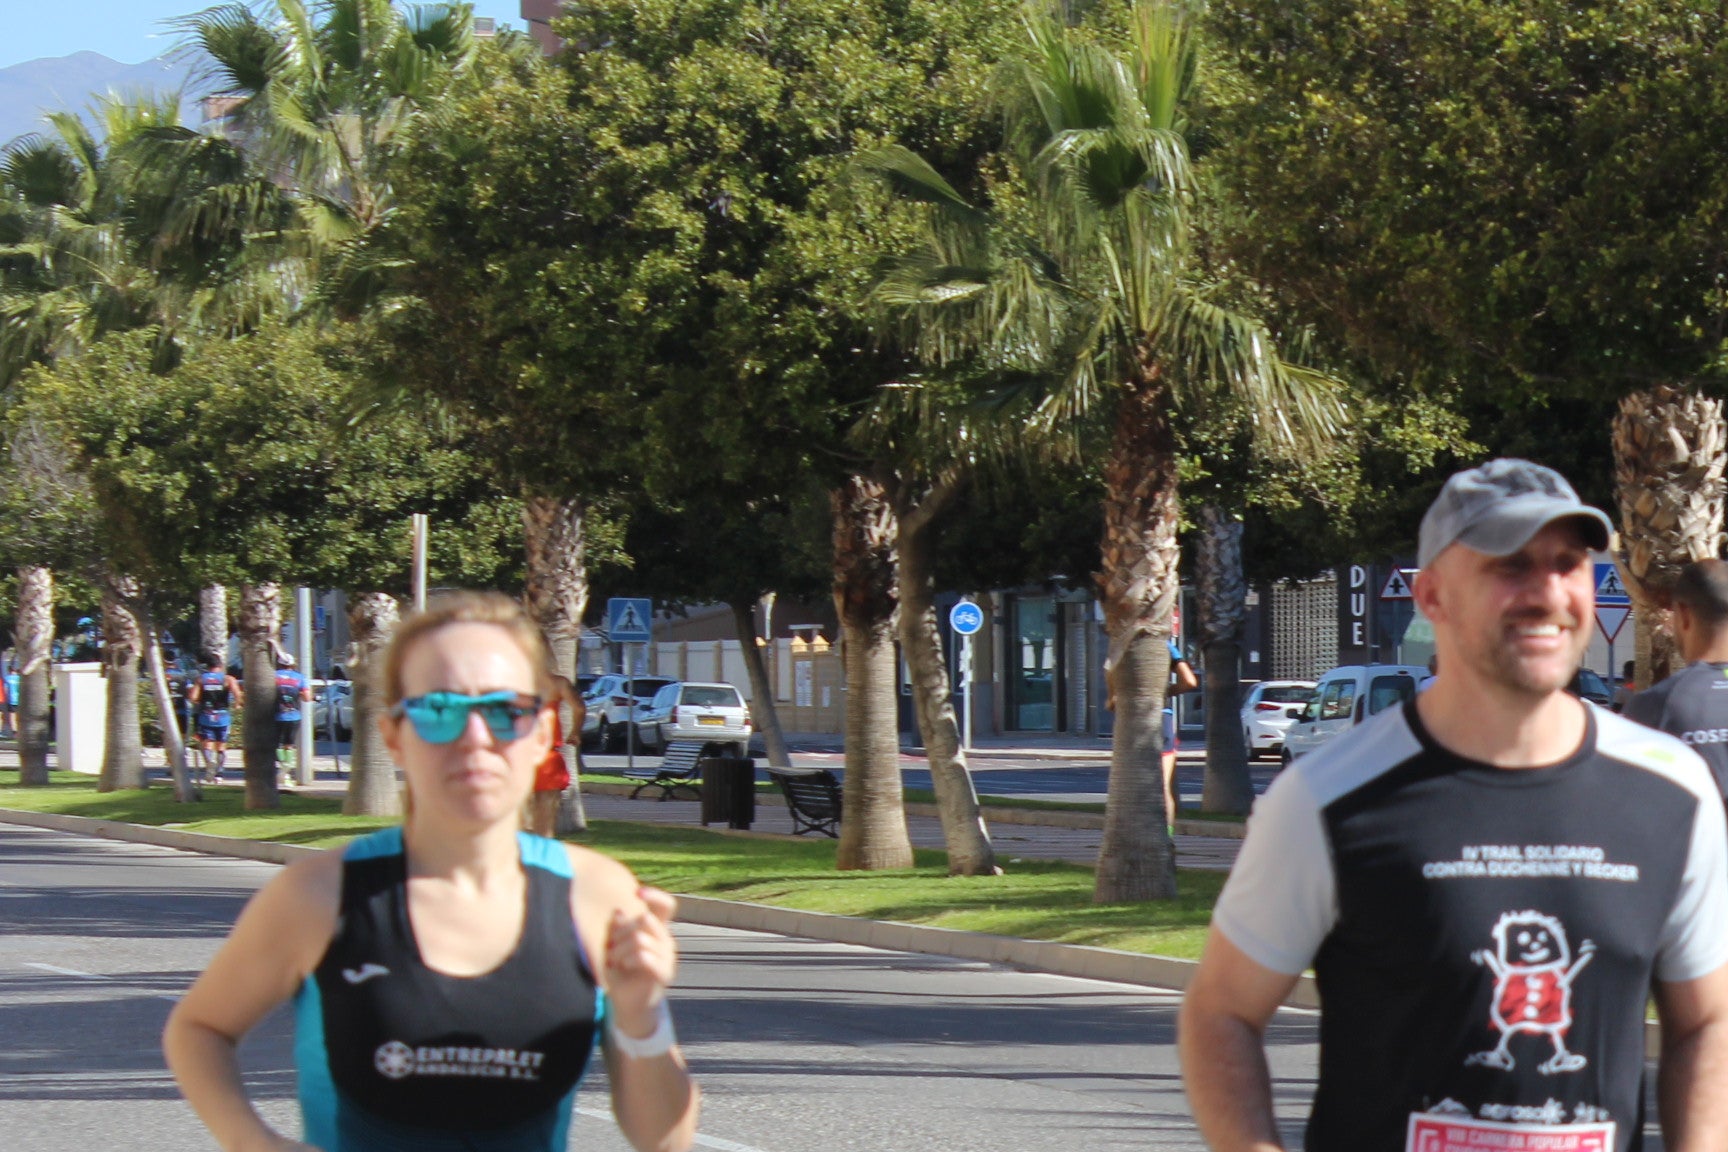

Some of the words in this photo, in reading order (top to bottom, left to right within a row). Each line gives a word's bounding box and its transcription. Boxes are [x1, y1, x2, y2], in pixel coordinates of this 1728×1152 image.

[1350, 564, 1366, 646] DUE
[1462, 846, 1479, 861] IV
[1481, 845, 1523, 861] TRAIL
[1524, 845, 1605, 863] SOLIDARIO
[1422, 861, 1487, 879] CONTRA
[1487, 860, 1571, 878] DUCHENNE
[1571, 861, 1583, 878] Y
[1583, 862, 1640, 882] BECKER
[415, 1046, 545, 1068] ENTREPALET
[1468, 1129, 1526, 1149] CARRERA
[1526, 1133, 1580, 1150] POPULAR
